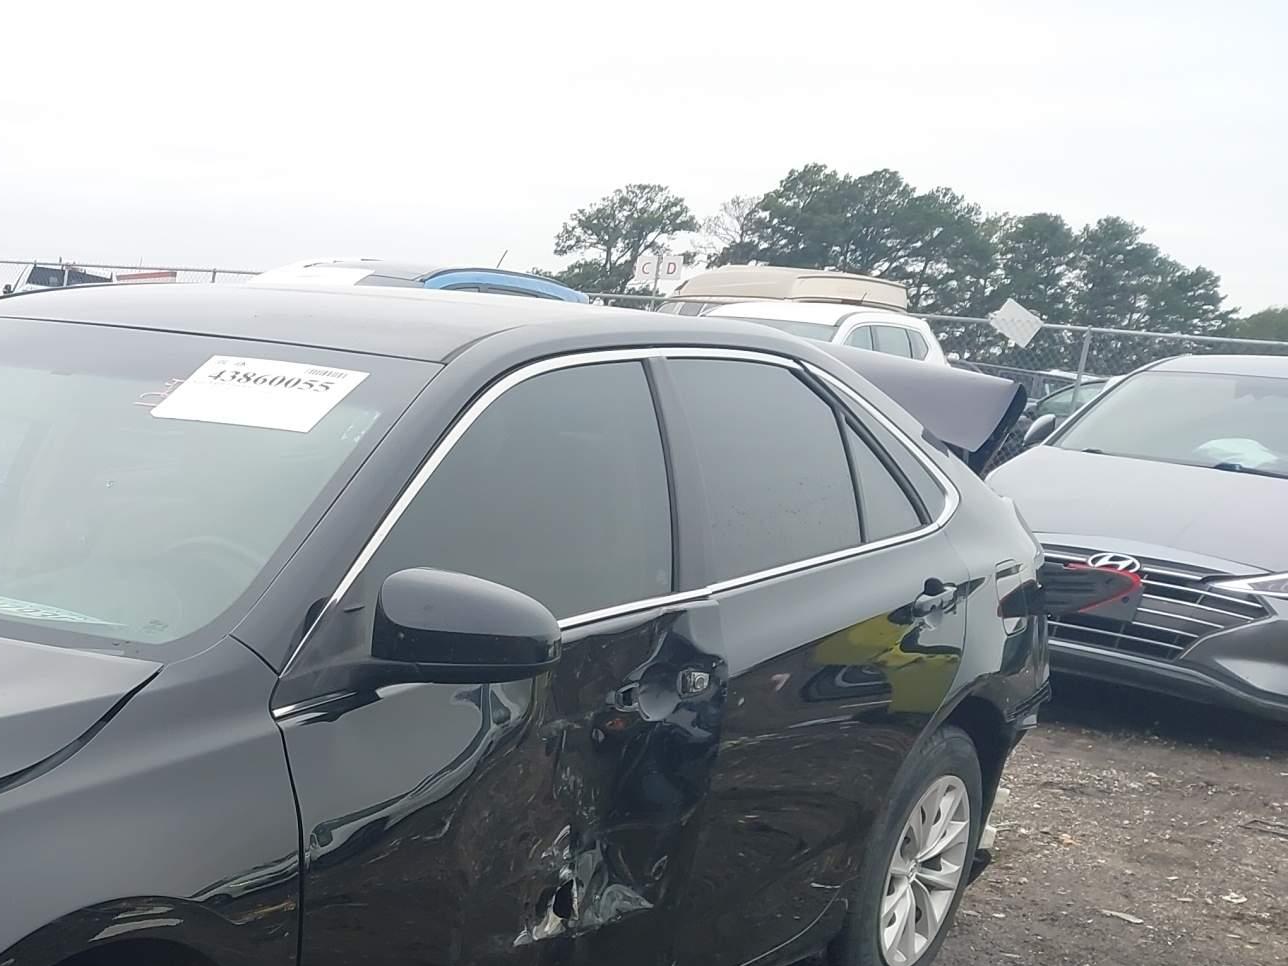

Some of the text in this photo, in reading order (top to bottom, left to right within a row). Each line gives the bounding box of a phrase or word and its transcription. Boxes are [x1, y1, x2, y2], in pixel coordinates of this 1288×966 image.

[642, 262, 651, 275] C
[667, 262, 676, 275] D
[207, 368, 336, 393] 43860055
